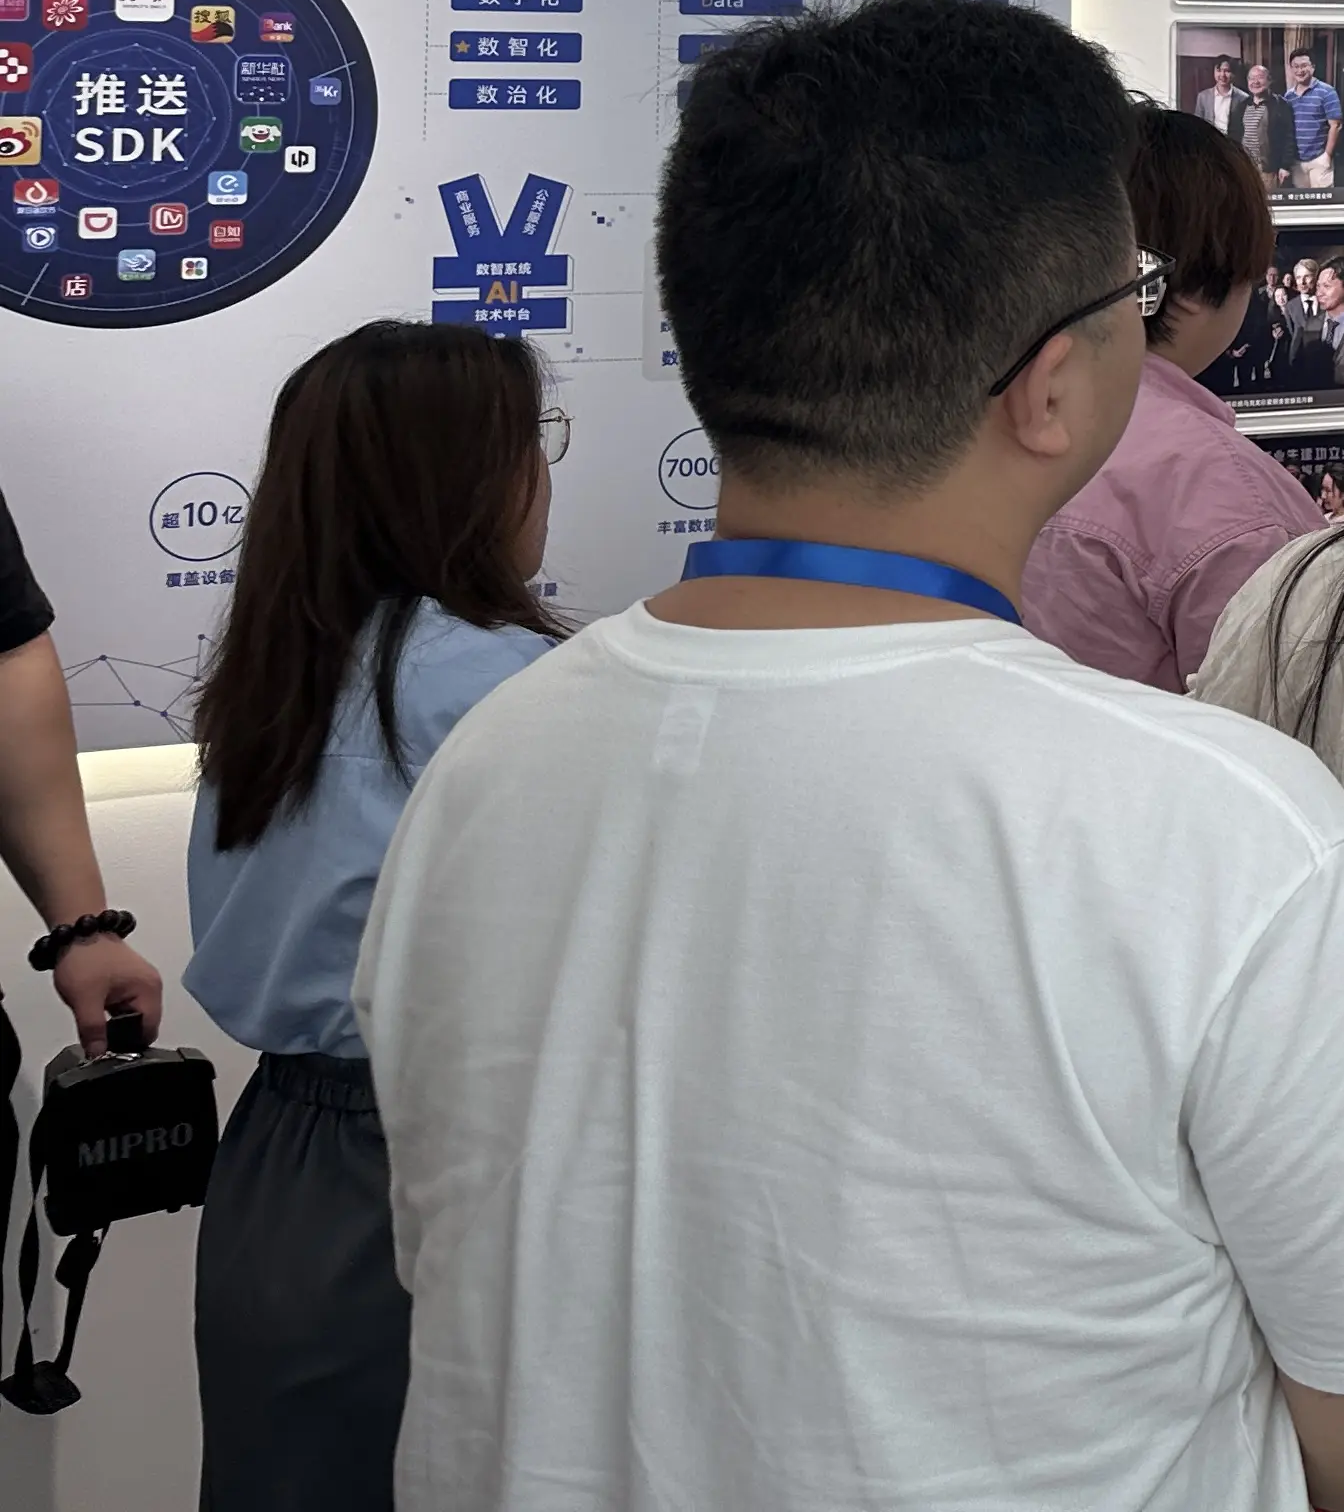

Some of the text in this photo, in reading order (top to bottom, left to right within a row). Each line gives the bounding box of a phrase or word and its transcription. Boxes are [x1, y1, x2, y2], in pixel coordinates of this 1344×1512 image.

[477, 37, 559, 58] 数智化
[75, 72, 188, 117] 推送
[476, 84, 558, 105] 数治化
[74, 127, 185, 163] SDK
[454, 190, 481, 238] 商业服务
[522, 189, 549, 236] 公共服务
[476, 262, 532, 276] 数智系统
[65, 276, 88, 297] 店
[485, 280, 519, 305] AI
[475, 308, 531, 322] 技术中台
[78, 1122, 194, 1169] MIPRO
